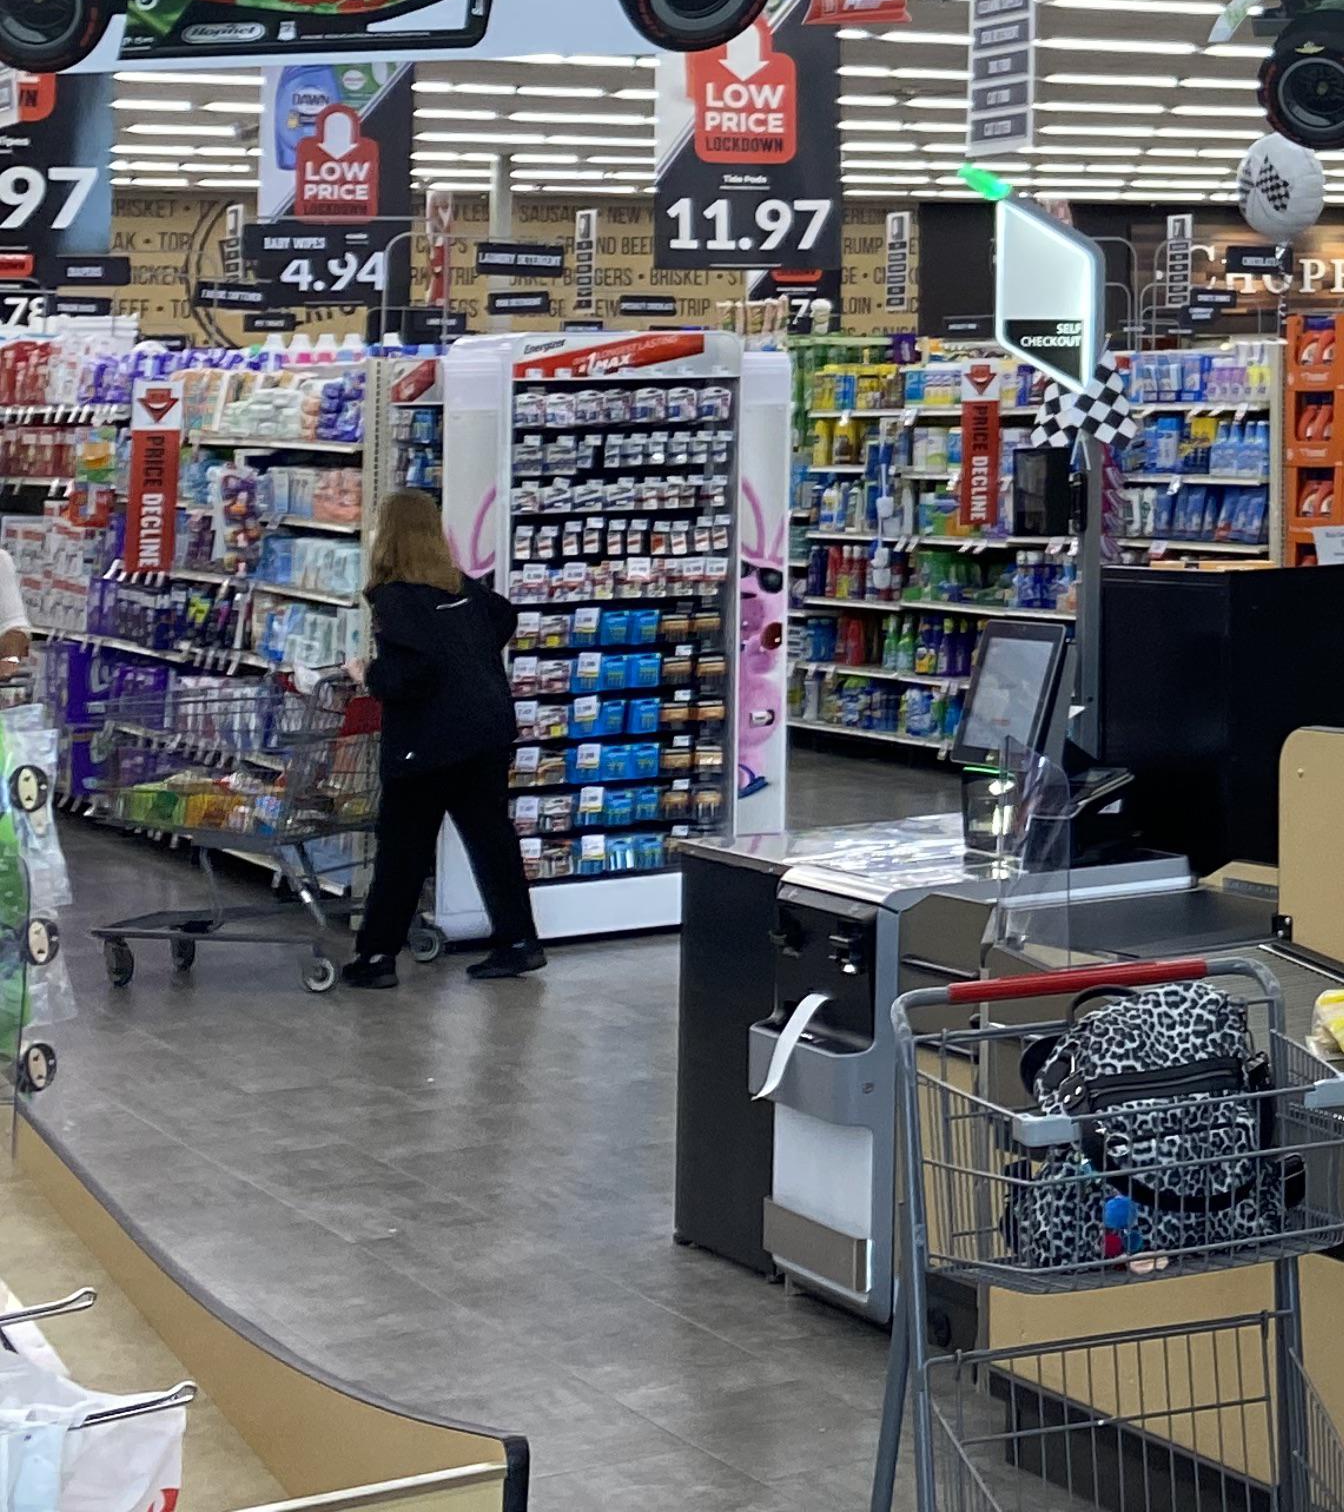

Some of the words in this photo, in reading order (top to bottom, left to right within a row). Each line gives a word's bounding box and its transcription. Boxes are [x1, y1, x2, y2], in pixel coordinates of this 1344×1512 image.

[292, 93, 330, 106] DAWN
[705, 82, 785, 109] LOW
[704, 112, 785, 134] PRICE
[705, 137, 784, 153] LOCKDOWN
[304, 161, 371, 182] LOW
[303, 183, 370, 201] PRICE
[666, 197, 832, 251] 11.97
[293, 236, 327, 250] WIPES
[279, 250, 387, 292] 4.94
[1056, 323, 1083, 334] SELF
[523, 338, 566, 355] Energizer
[1020, 336, 1082, 348] CHECKOUT
[970, 404, 988, 452] PRICE
[143, 435, 165, 487] PRICE
[970, 455, 989, 521] DECLINE
[138, 492, 164, 568] DECLINE
